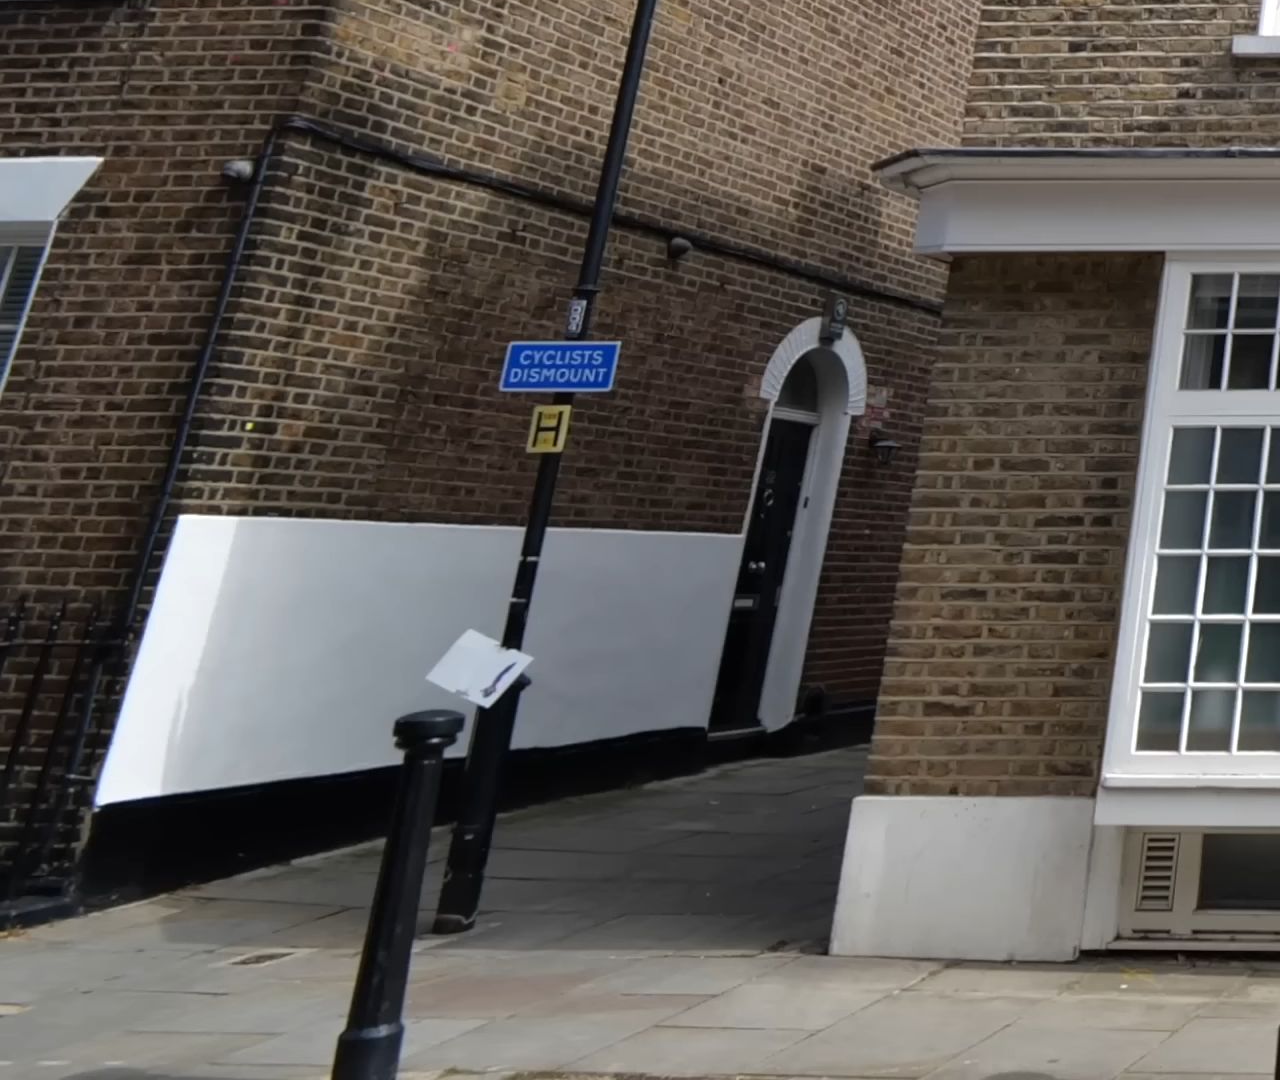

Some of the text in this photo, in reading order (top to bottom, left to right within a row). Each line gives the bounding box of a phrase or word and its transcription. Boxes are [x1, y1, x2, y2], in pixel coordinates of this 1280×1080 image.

[520, 350, 604, 365] CYCLISTS
[509, 368, 608, 383] DISMOUNT
[531, 411, 564, 448] H
